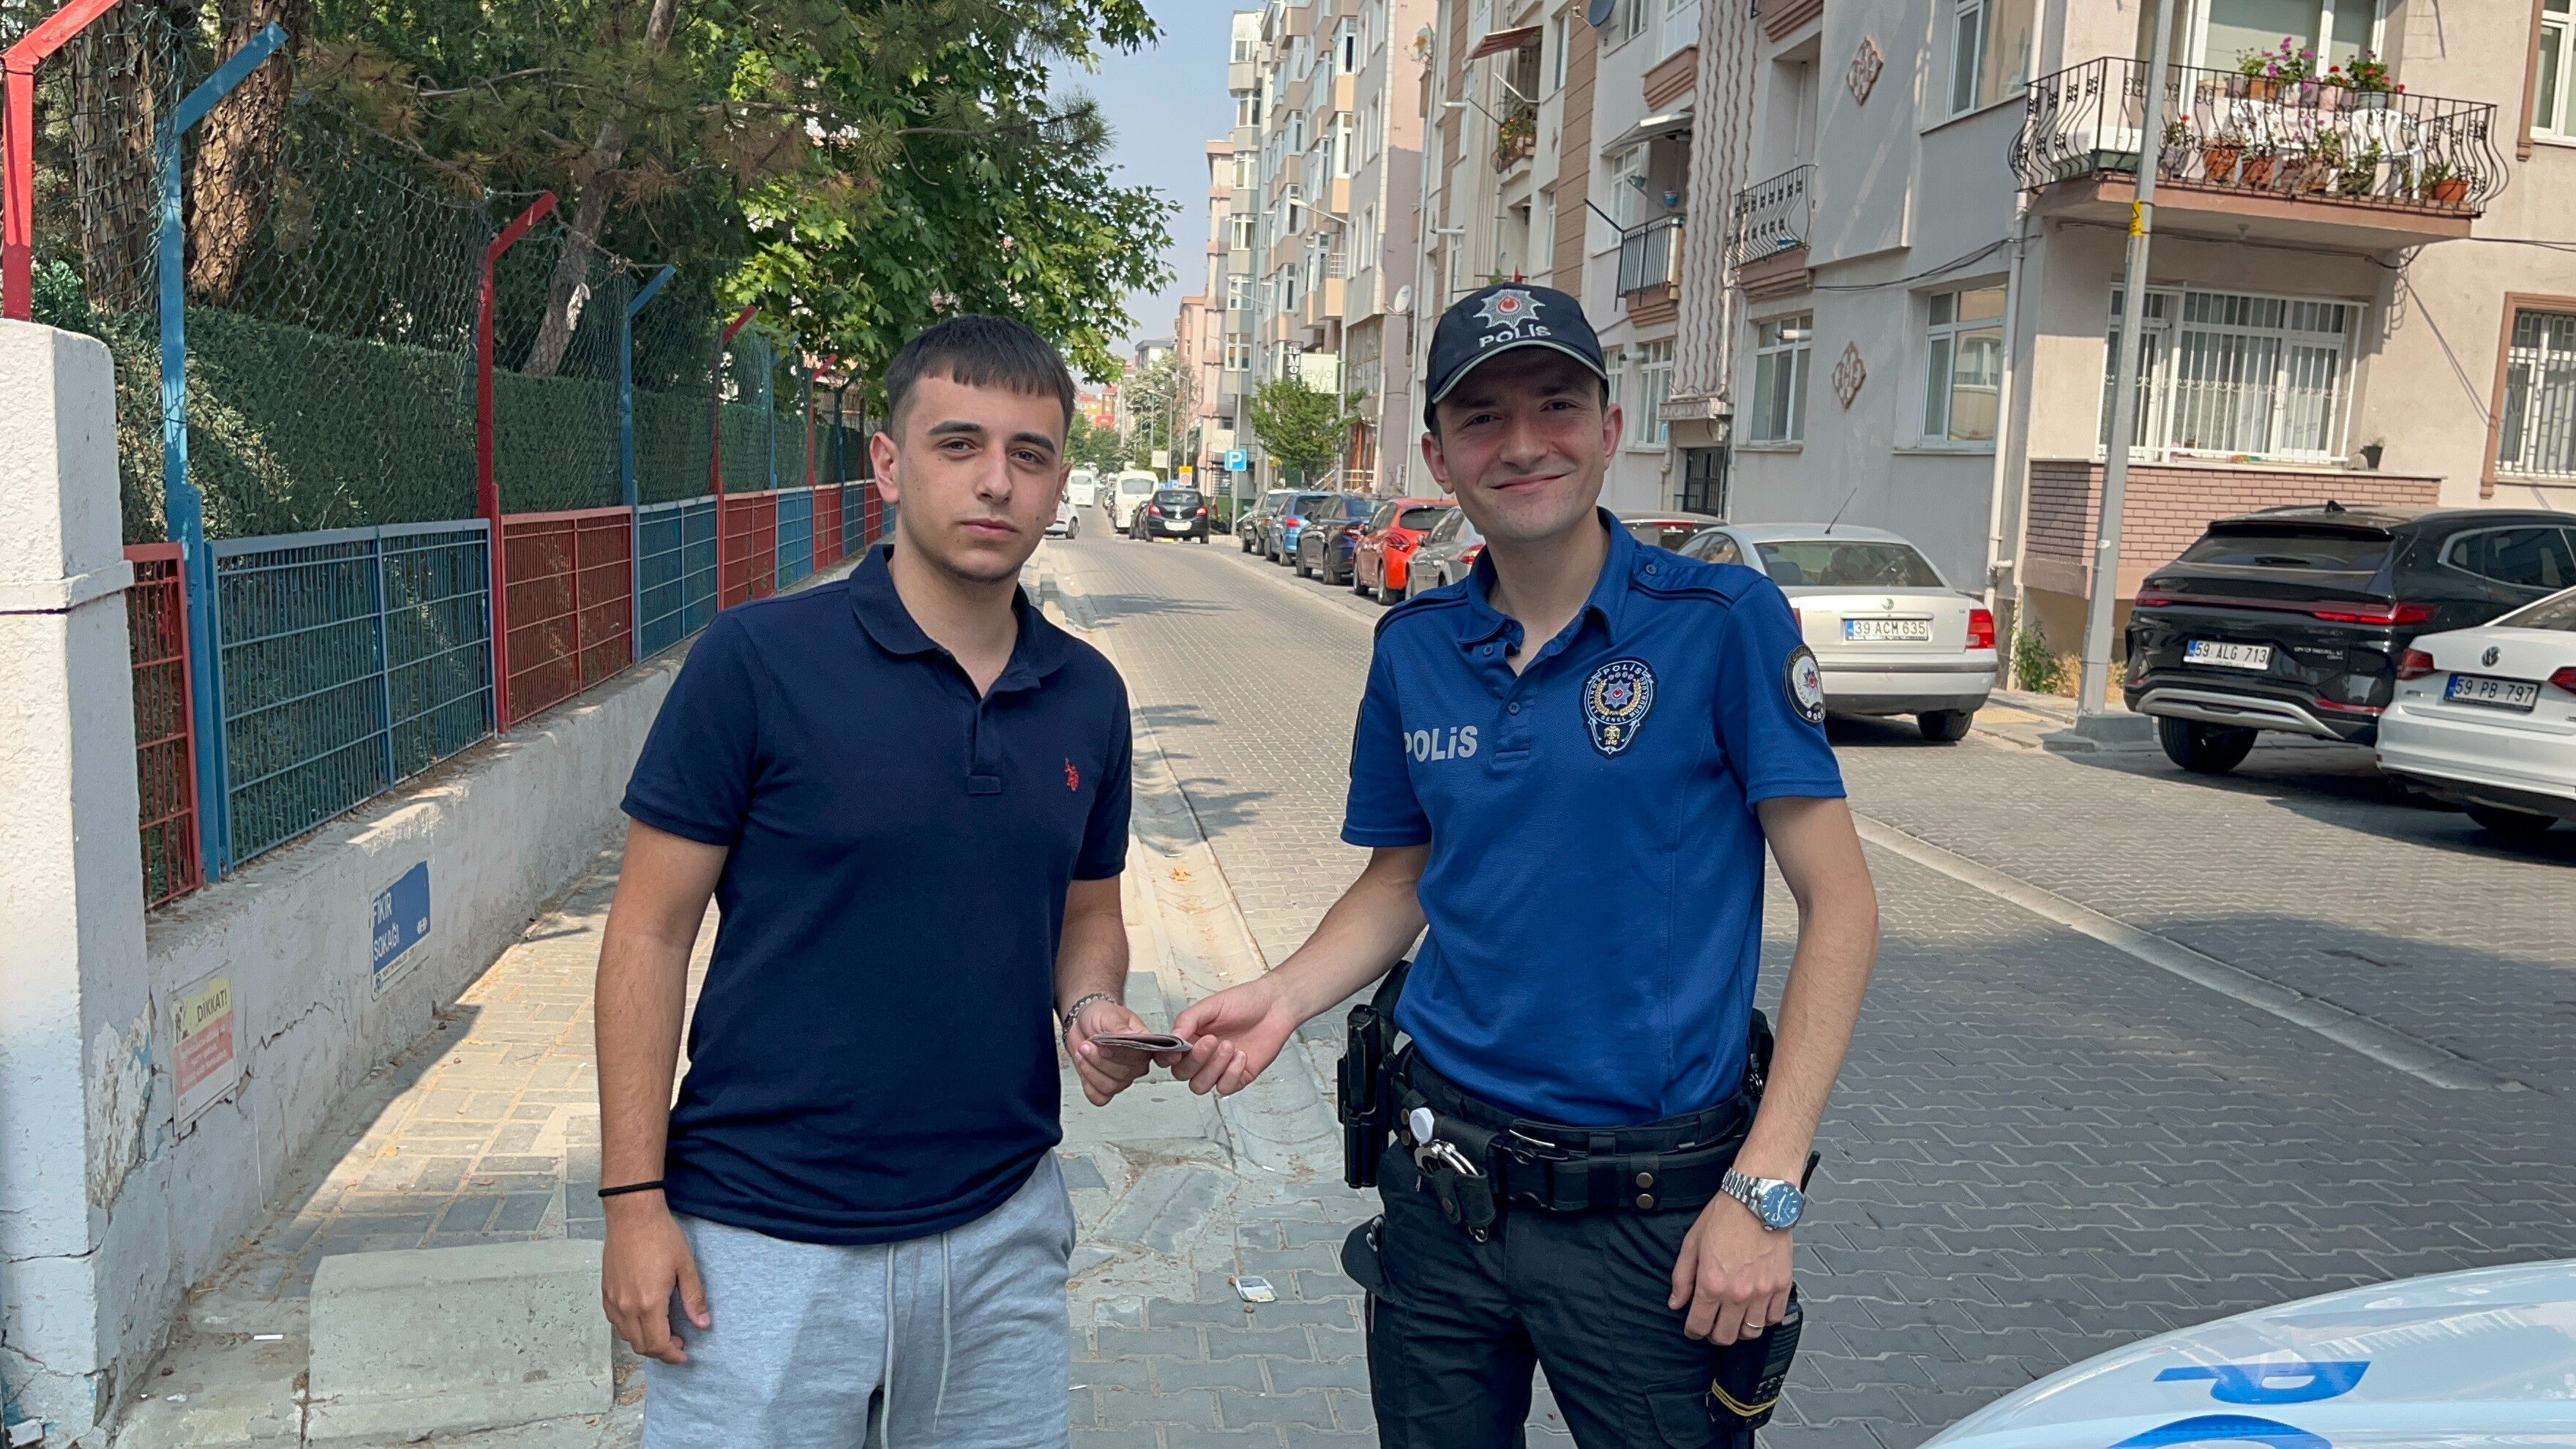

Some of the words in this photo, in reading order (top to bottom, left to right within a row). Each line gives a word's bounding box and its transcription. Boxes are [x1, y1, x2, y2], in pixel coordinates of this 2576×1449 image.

[1229, 452, 1243, 469] P
[1855, 621, 1871, 634] 39
[1875, 621, 1898, 634] ACM
[1903, 621, 1925, 634] 635
[2195, 642, 2210, 658] 59
[2215, 644, 2239, 661] ALG
[2244, 647, 2268, 664] 713
[2455, 678, 2474, 695] 59
[2479, 681, 2498, 698] PB
[2506, 684, 2534, 703] 797
[373, 922, 400, 962] SOKAĞI
[196, 988, 228, 1023] DİKKAT!
